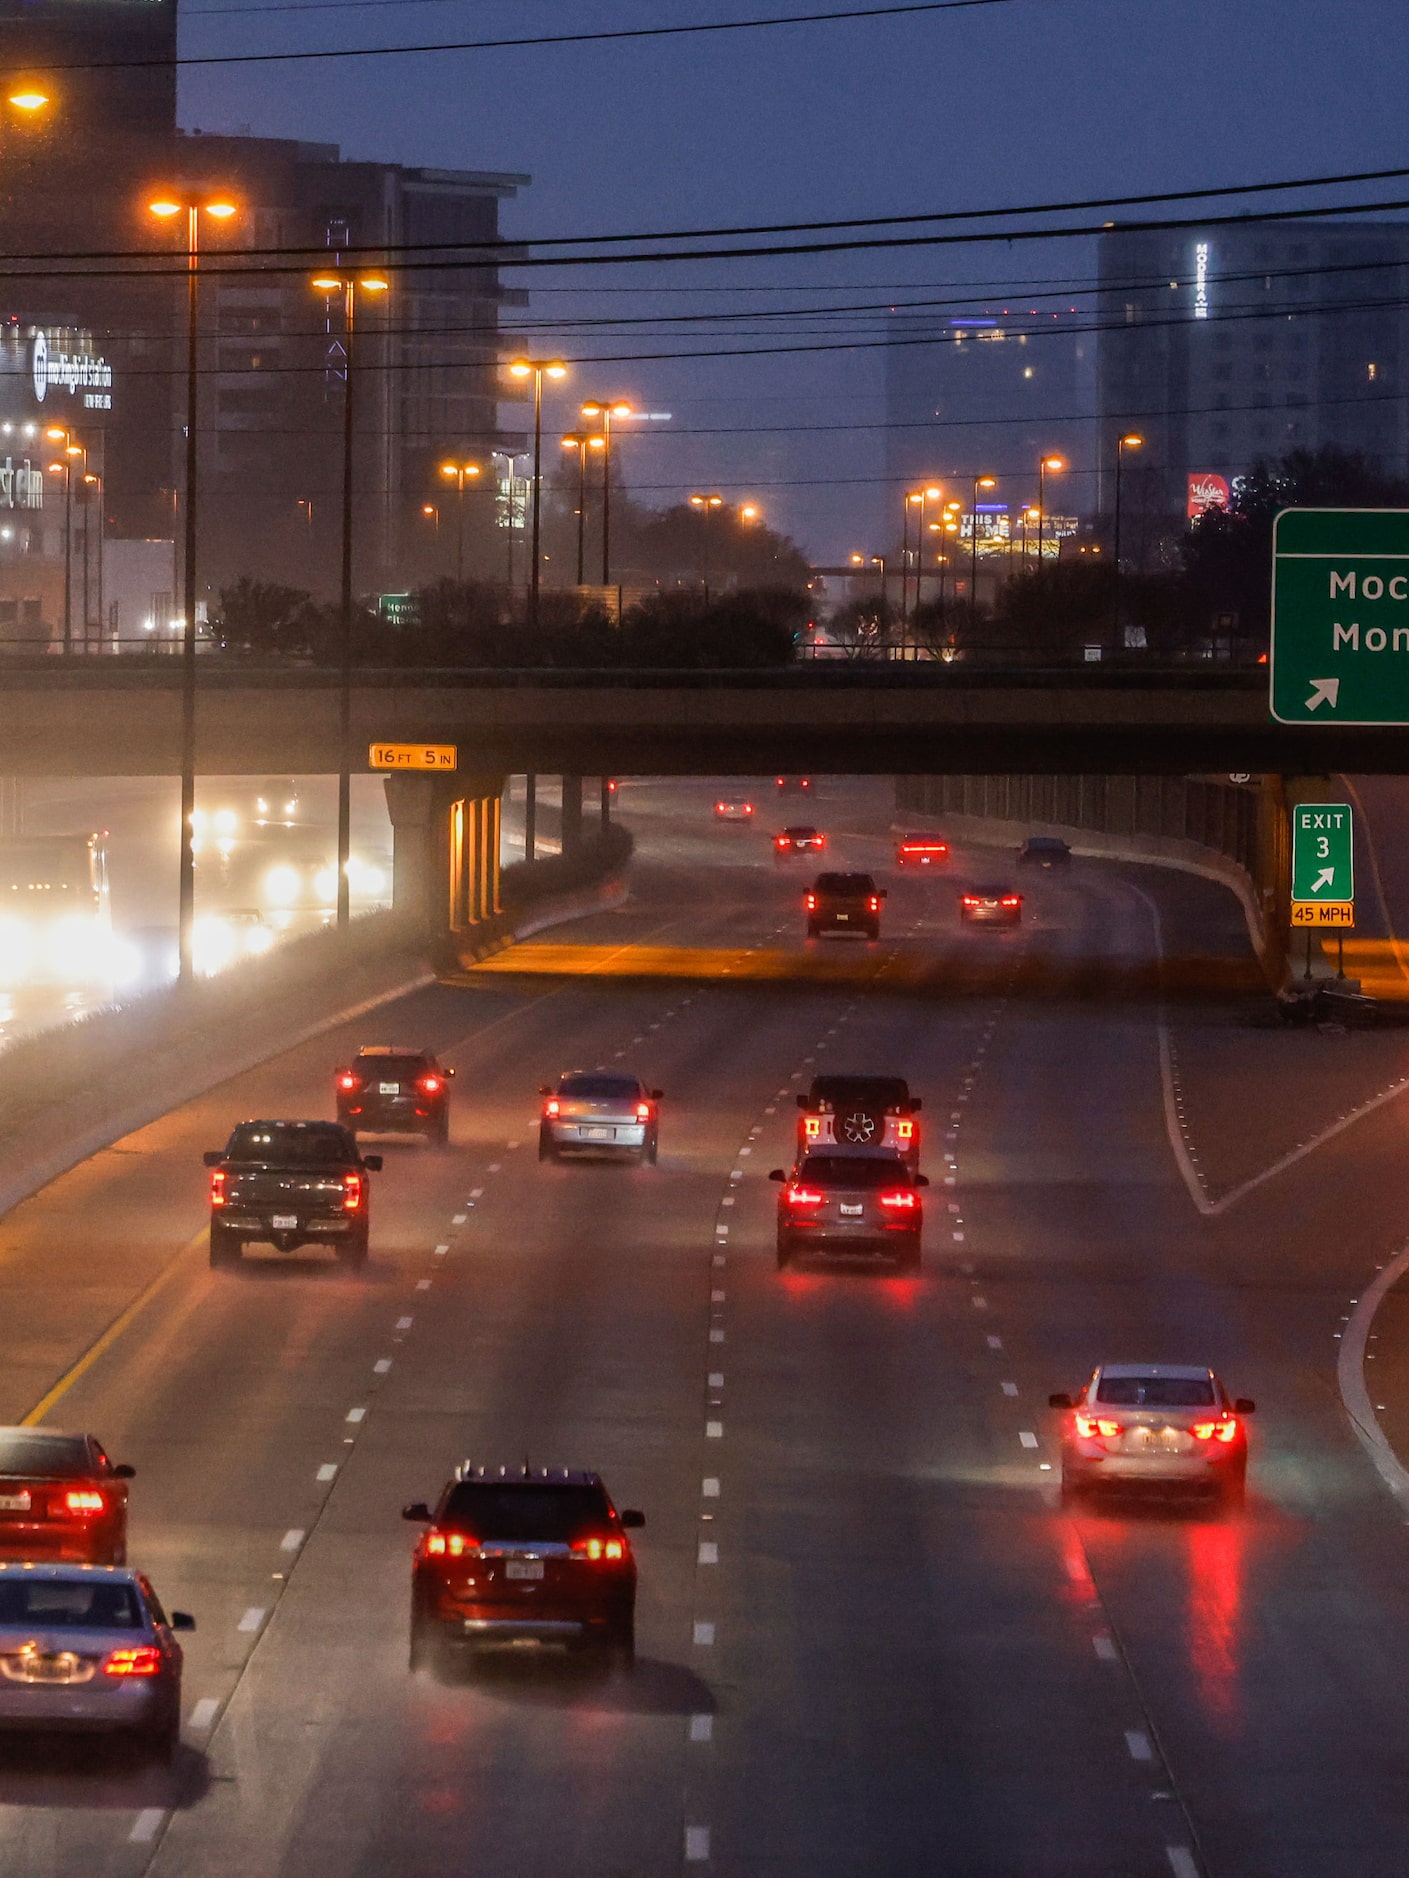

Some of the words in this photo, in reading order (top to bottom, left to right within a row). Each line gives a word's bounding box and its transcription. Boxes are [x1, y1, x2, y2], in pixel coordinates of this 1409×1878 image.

[1329, 571, 1408, 600] Moc
[1301, 814, 1344, 829] EXIT
[1316, 836, 1330, 858] 3
[1294, 907, 1314, 921] 45
[1319, 908, 1350, 921] MPH
